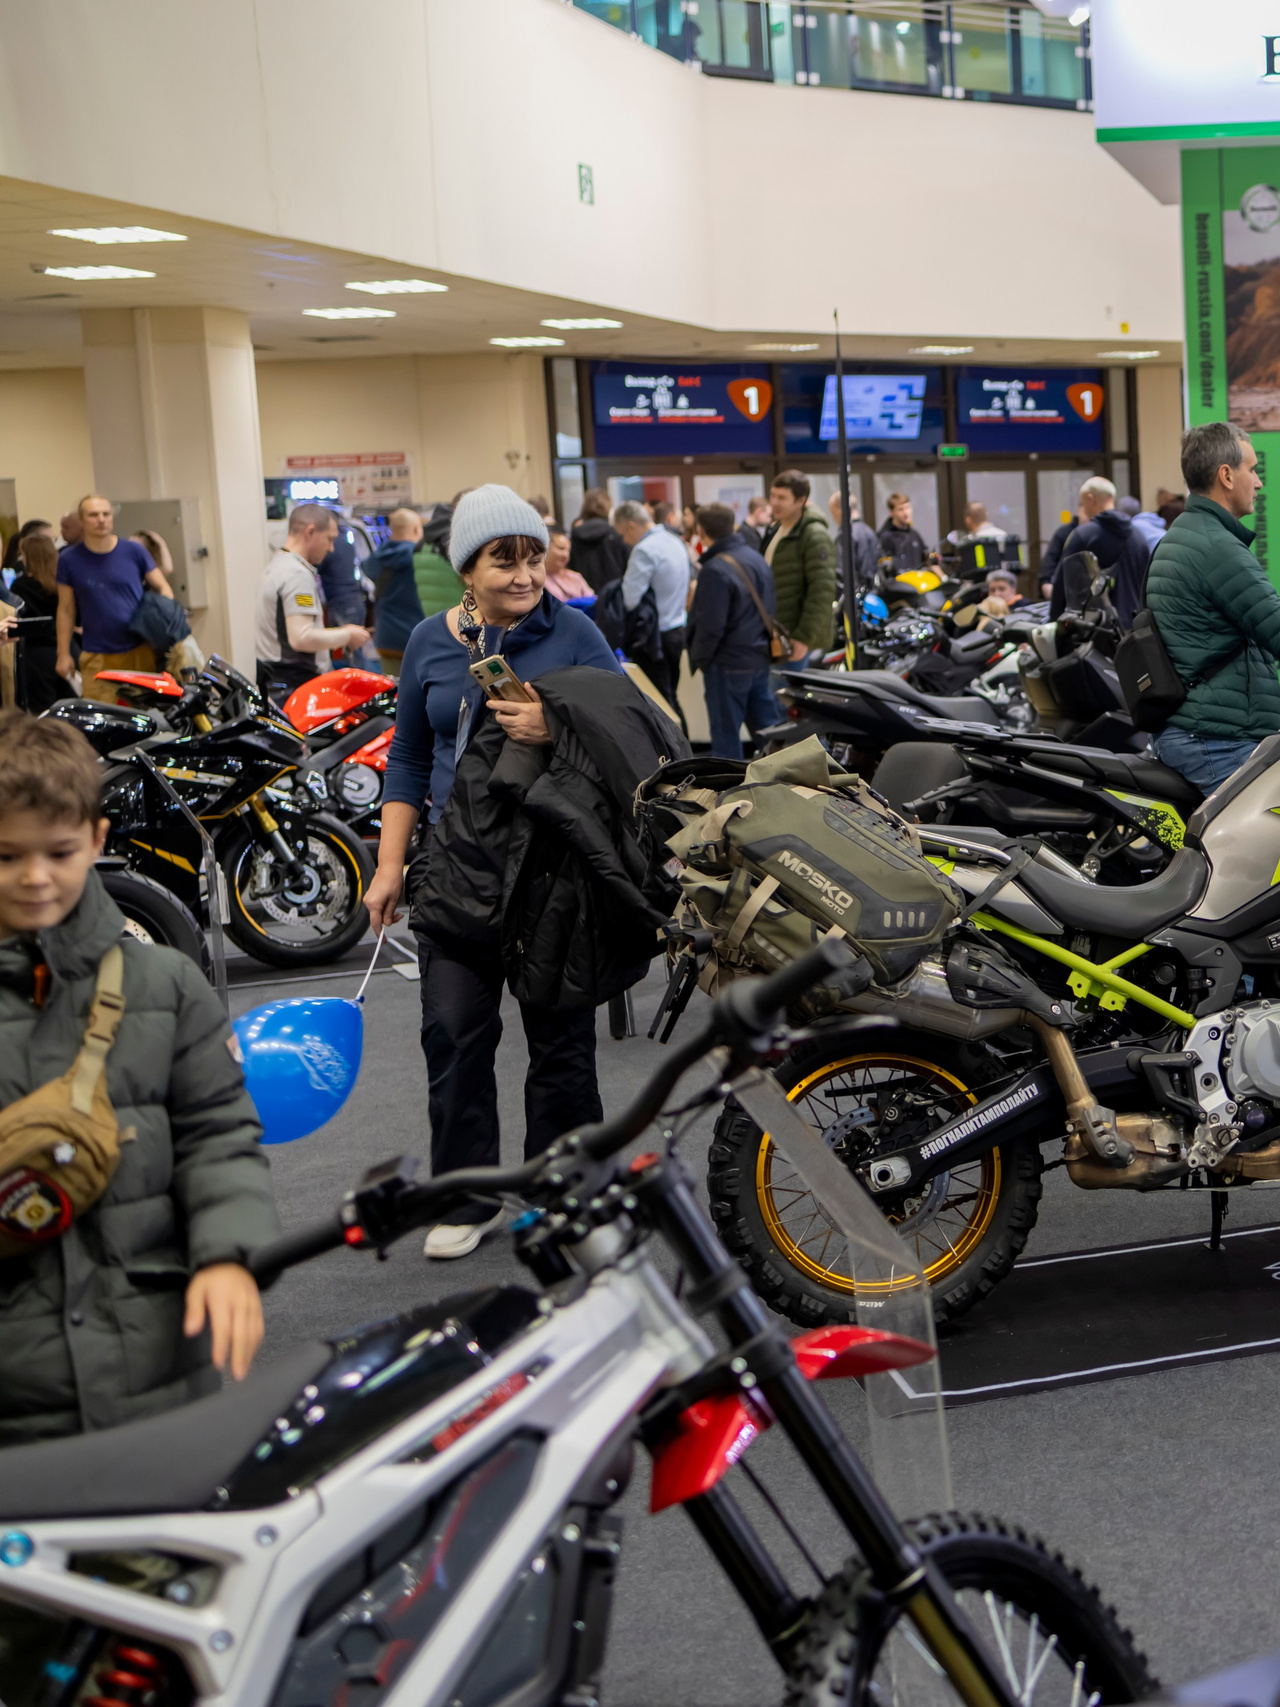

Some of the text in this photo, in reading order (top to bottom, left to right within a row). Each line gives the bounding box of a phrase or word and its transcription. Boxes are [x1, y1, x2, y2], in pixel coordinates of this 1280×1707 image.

[1195, 212, 1214, 408] benelli-russia.com/dealer
[743, 386, 759, 415] 1
[1080, 390, 1093, 416] 1
[777, 850, 854, 909] MOSKO
[820, 895, 845, 916] MOTO
